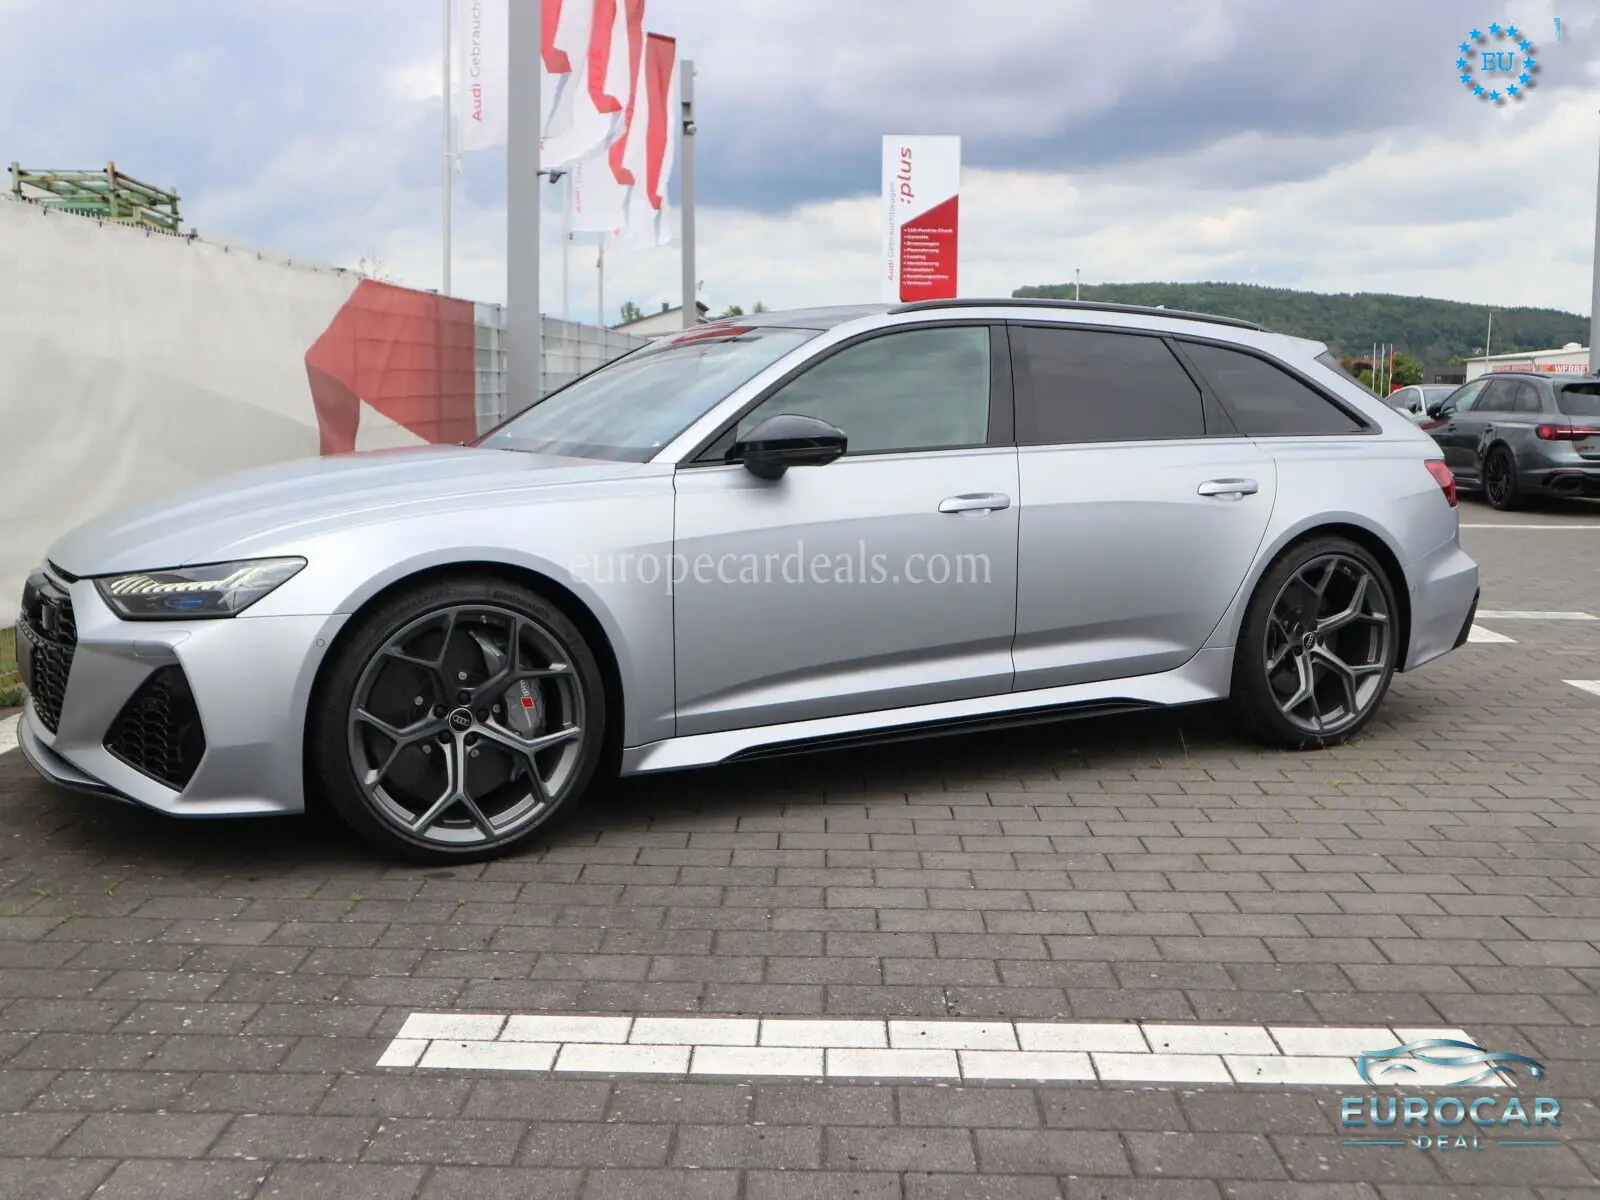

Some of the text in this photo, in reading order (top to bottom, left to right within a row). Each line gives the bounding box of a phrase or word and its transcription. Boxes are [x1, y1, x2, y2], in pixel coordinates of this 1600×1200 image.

[469, 0, 482, 122] Audi Gebrauch
[887, 259, 896, 281] Audi
